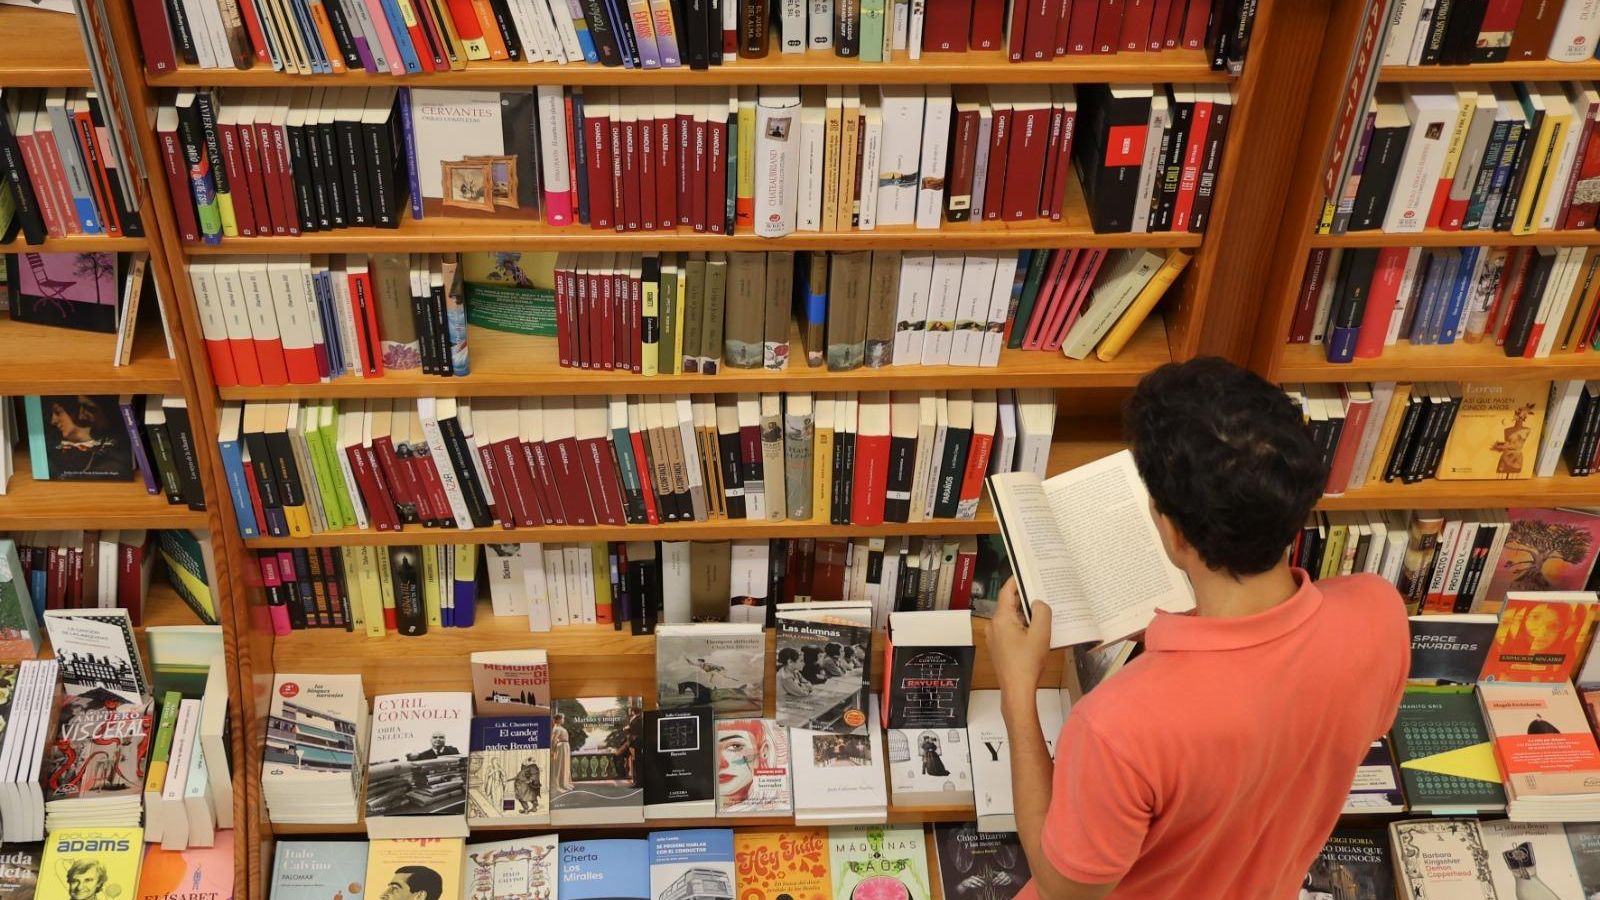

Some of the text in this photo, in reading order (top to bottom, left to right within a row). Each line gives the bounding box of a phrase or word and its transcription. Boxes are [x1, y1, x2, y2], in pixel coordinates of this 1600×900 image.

[1326, 1, 1379, 189] ARRATIVA
[421, 104, 493, 118] CERVANTES
[198, 98, 218, 165] JAVIER CERCAS
[594, 122, 602, 150] CHANDLER
[768, 149, 778, 207] CHATEAUBRIAND
[1166, 166, 1180, 182] CHILD
[1184, 166, 1197, 180] CHILD
[1201, 172, 1214, 187] CHILD
[1482, 403, 1509, 411] AÑOS
[1492, 397, 1515, 405] PASEN
[1432, 560, 1446, 589] PROYECTO
[1448, 562, 1463, 591] PROYECTO
[782, 624, 841, 637] Las alumnas
[1413, 634, 1457, 642] SPACE
[1410, 642, 1479, 651] INVADERS
[378, 697, 427, 711] CYRIL
[75, 712, 140, 722] AMPUERO
[377, 708, 462, 722] CONNOLLY
[61, 718, 148, 742] VISCERAL
[500, 728, 538, 737] El candor
[376, 733, 414, 742] SELECTA
[485, 742, 538, 751] padre Brown
[956, 832, 1008, 842] Chico Bizarro
[563, 845, 585, 854] Kike
[836, 839, 917, 853] MÁQUINAS
[1335, 845, 1362, 854] DIGAS
[1363, 847, 1383, 856] QUE
[0, 852, 33, 866] uda
[284, 849, 314, 859] Italo
[563, 854, 598, 863] Cherta
[736, 833, 824, 877] Hey Jude
[1335, 854, 1382, 863] CONOCES
[282, 859, 332, 871] Calvino
[1424, 857, 1460, 865] Kingsolver
[0, 864, 33, 879] leta
[563, 864, 581, 873] Los
[1427, 870, 1472, 878] Copperhead
[563, 872, 604, 882] Miralles
